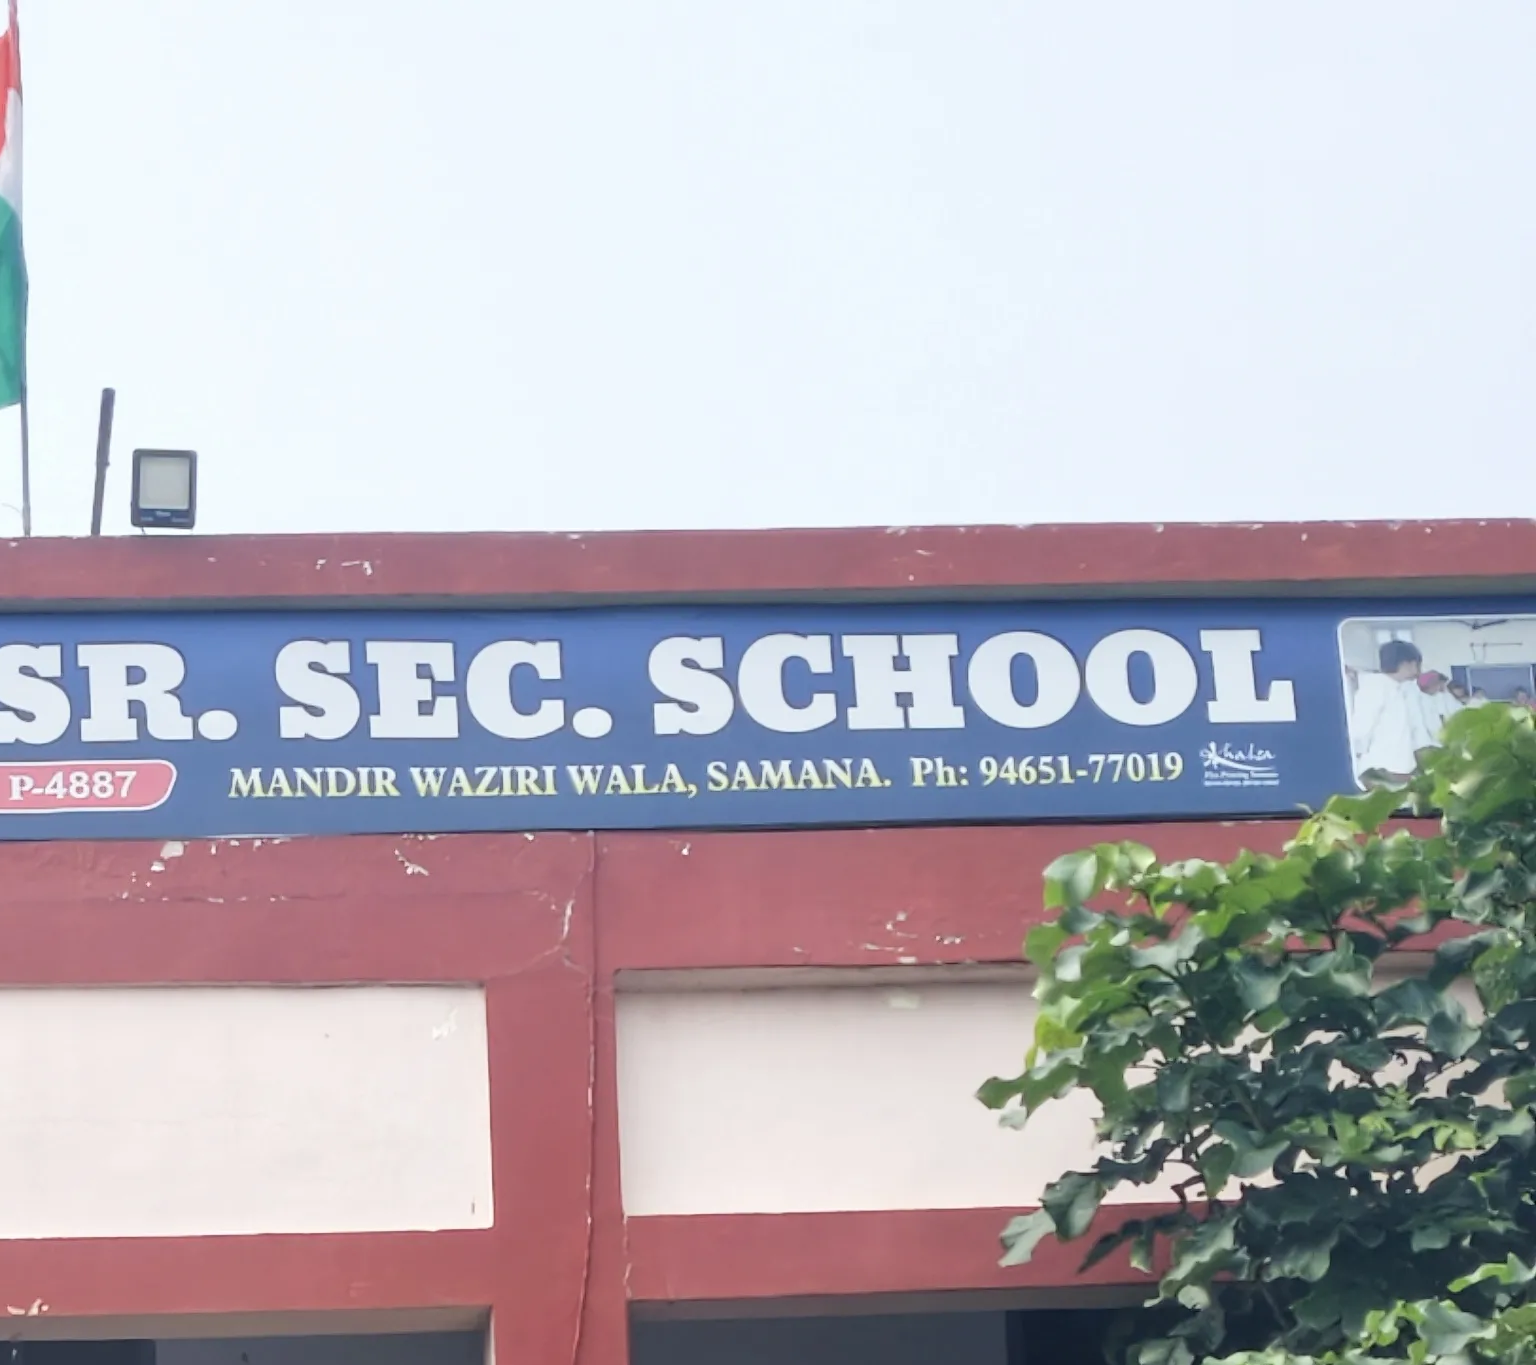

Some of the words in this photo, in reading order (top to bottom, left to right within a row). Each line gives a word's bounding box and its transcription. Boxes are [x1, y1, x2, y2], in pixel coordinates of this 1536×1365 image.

[274, 637, 614, 741] SEC.
[647, 628, 1297, 737] SCHOOL
[9, 770, 137, 801] P-4887
[229, 766, 400, 799] MANDIR
[410, 765, 558, 797] WAZIRI
[567, 764, 698, 799] WALA,
[707, 757, 891, 793] SAMANA.
[979, 751, 1184, 787] 94651-77019
